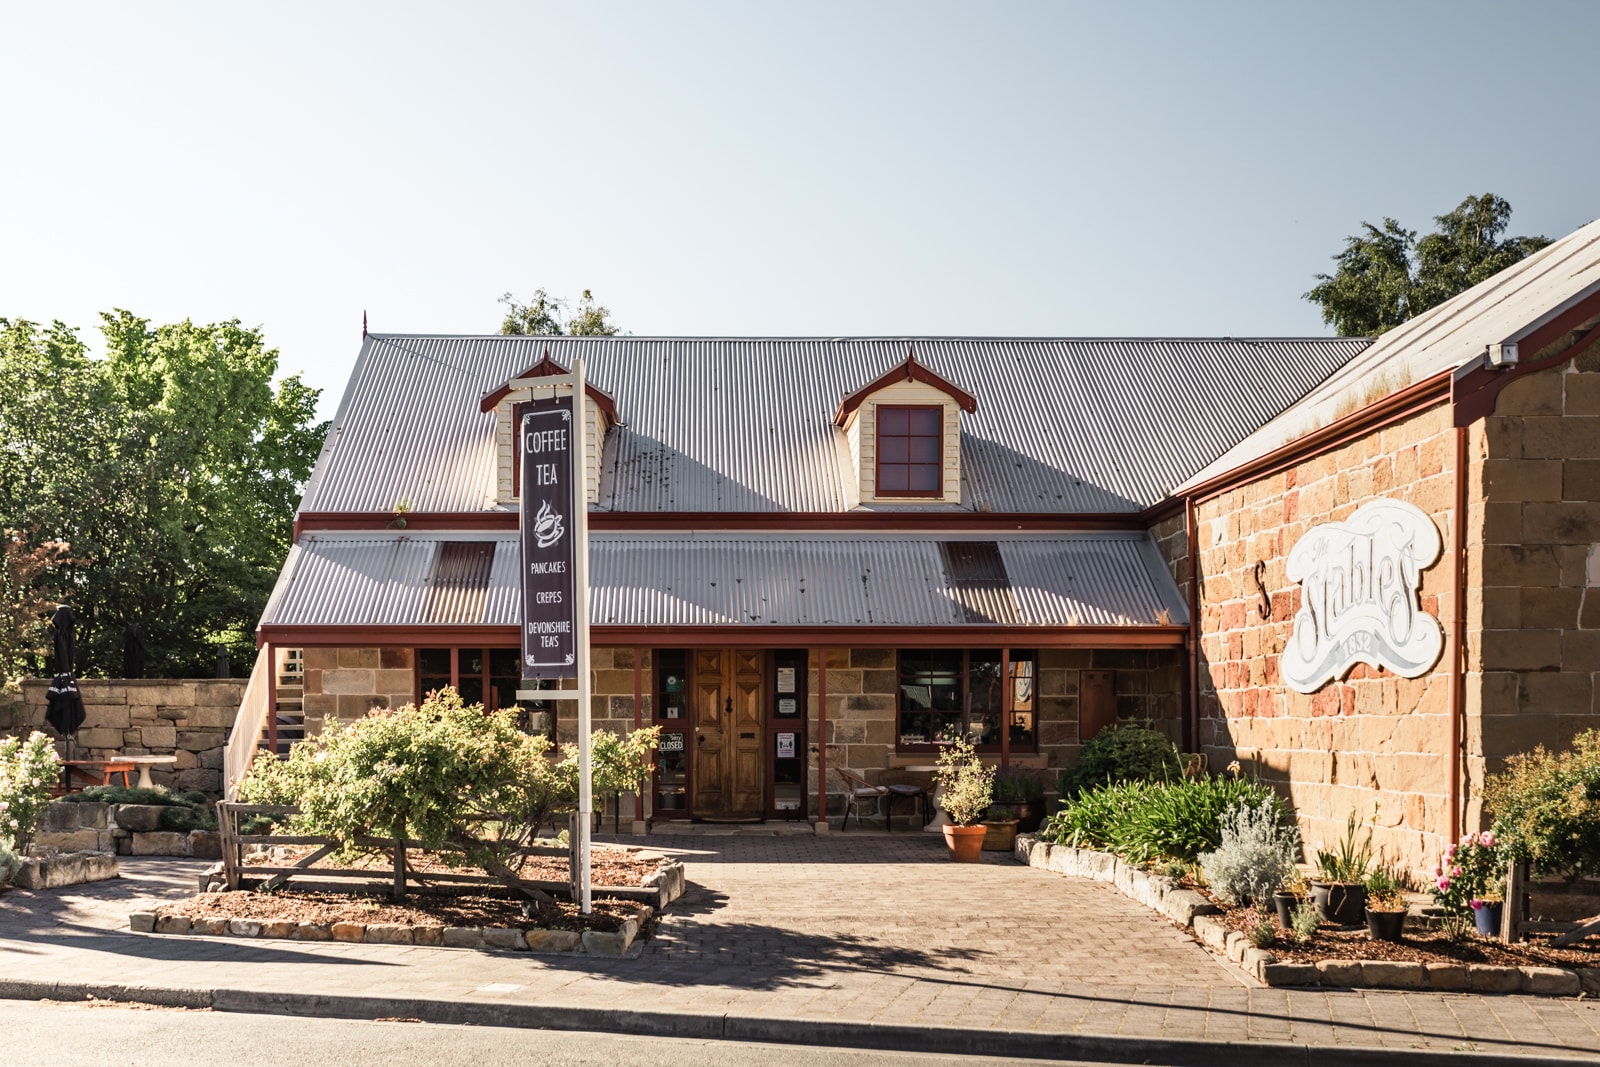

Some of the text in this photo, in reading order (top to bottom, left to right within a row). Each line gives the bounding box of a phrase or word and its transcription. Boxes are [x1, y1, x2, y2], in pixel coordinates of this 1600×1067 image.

[526, 429, 567, 454] COFFEE
[536, 464, 558, 485] TEA
[531, 561, 566, 575] PANCAKES
[536, 591, 562, 604] CREPES
[528, 620, 571, 634] DEVONSHIRE
[541, 635, 559, 648] TEA'S
[1343, 632, 1373, 660] 1832
[660, 741, 682, 750] CLOSED
